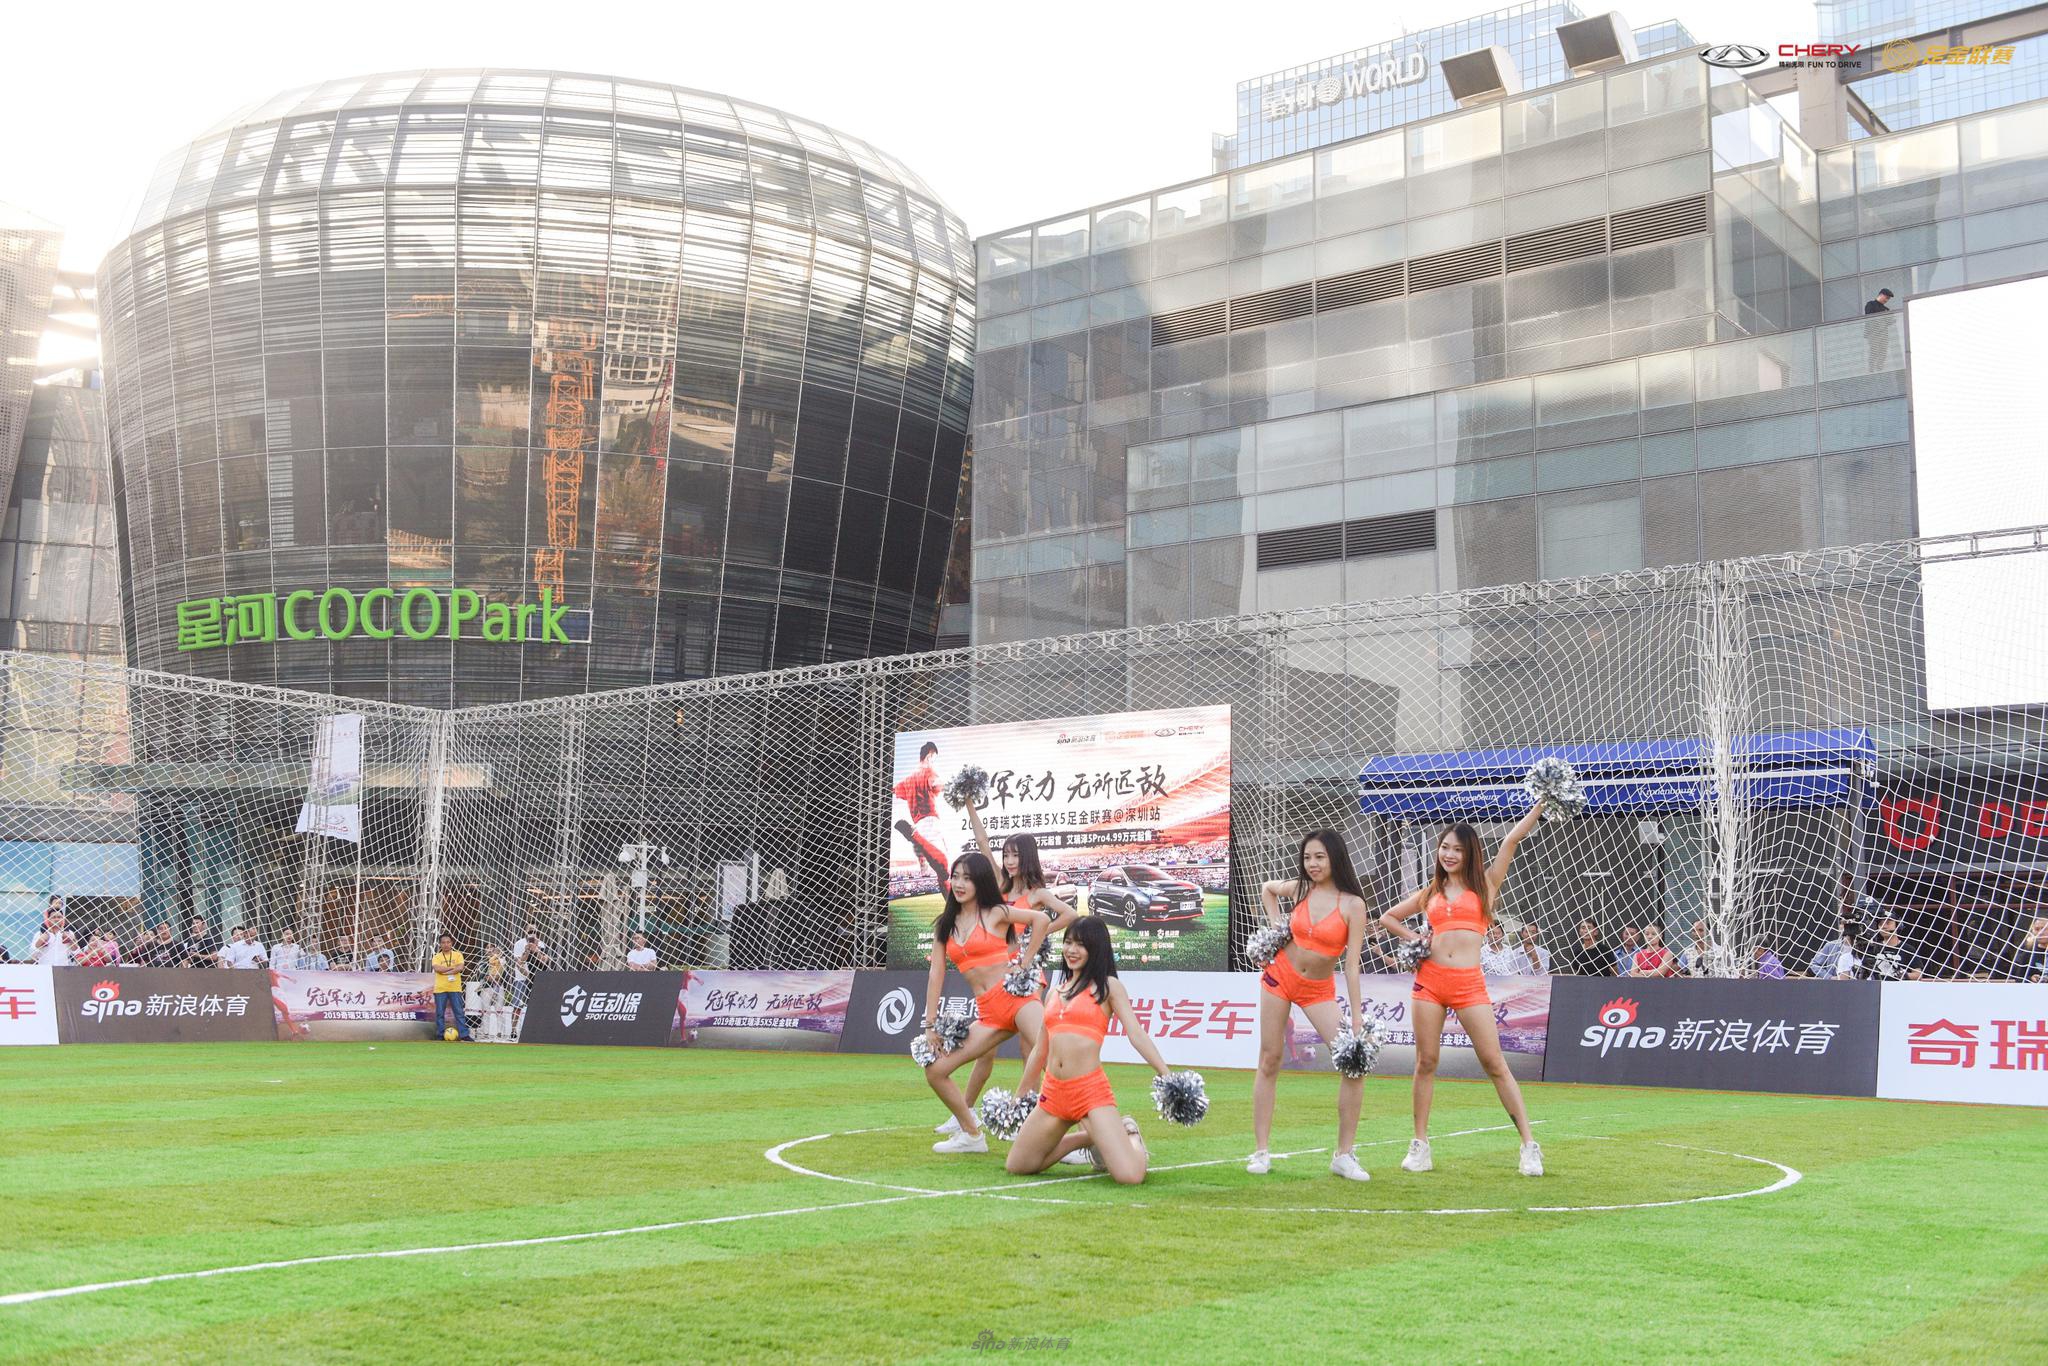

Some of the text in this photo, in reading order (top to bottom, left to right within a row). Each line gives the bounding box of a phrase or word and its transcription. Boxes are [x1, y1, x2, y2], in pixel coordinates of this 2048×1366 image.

[1344, 51, 1428, 99] WORLD
[177, 593, 277, 651] 星河
[974, 763, 1169, 811] 军实力 无所匹敌
[961, 805, 1161, 831] 209奇瑞艾瑞泽5X5足金联赛@深圳站
[0, 986, 37, 1020] 车
[81, 988, 250, 1024] sina 新浪体育
[587, 992, 643, 1014] 运动保
[1580, 1006, 1840, 1058] sina 新浪体育
[1907, 1018, 2048, 1071] 奇瑞
